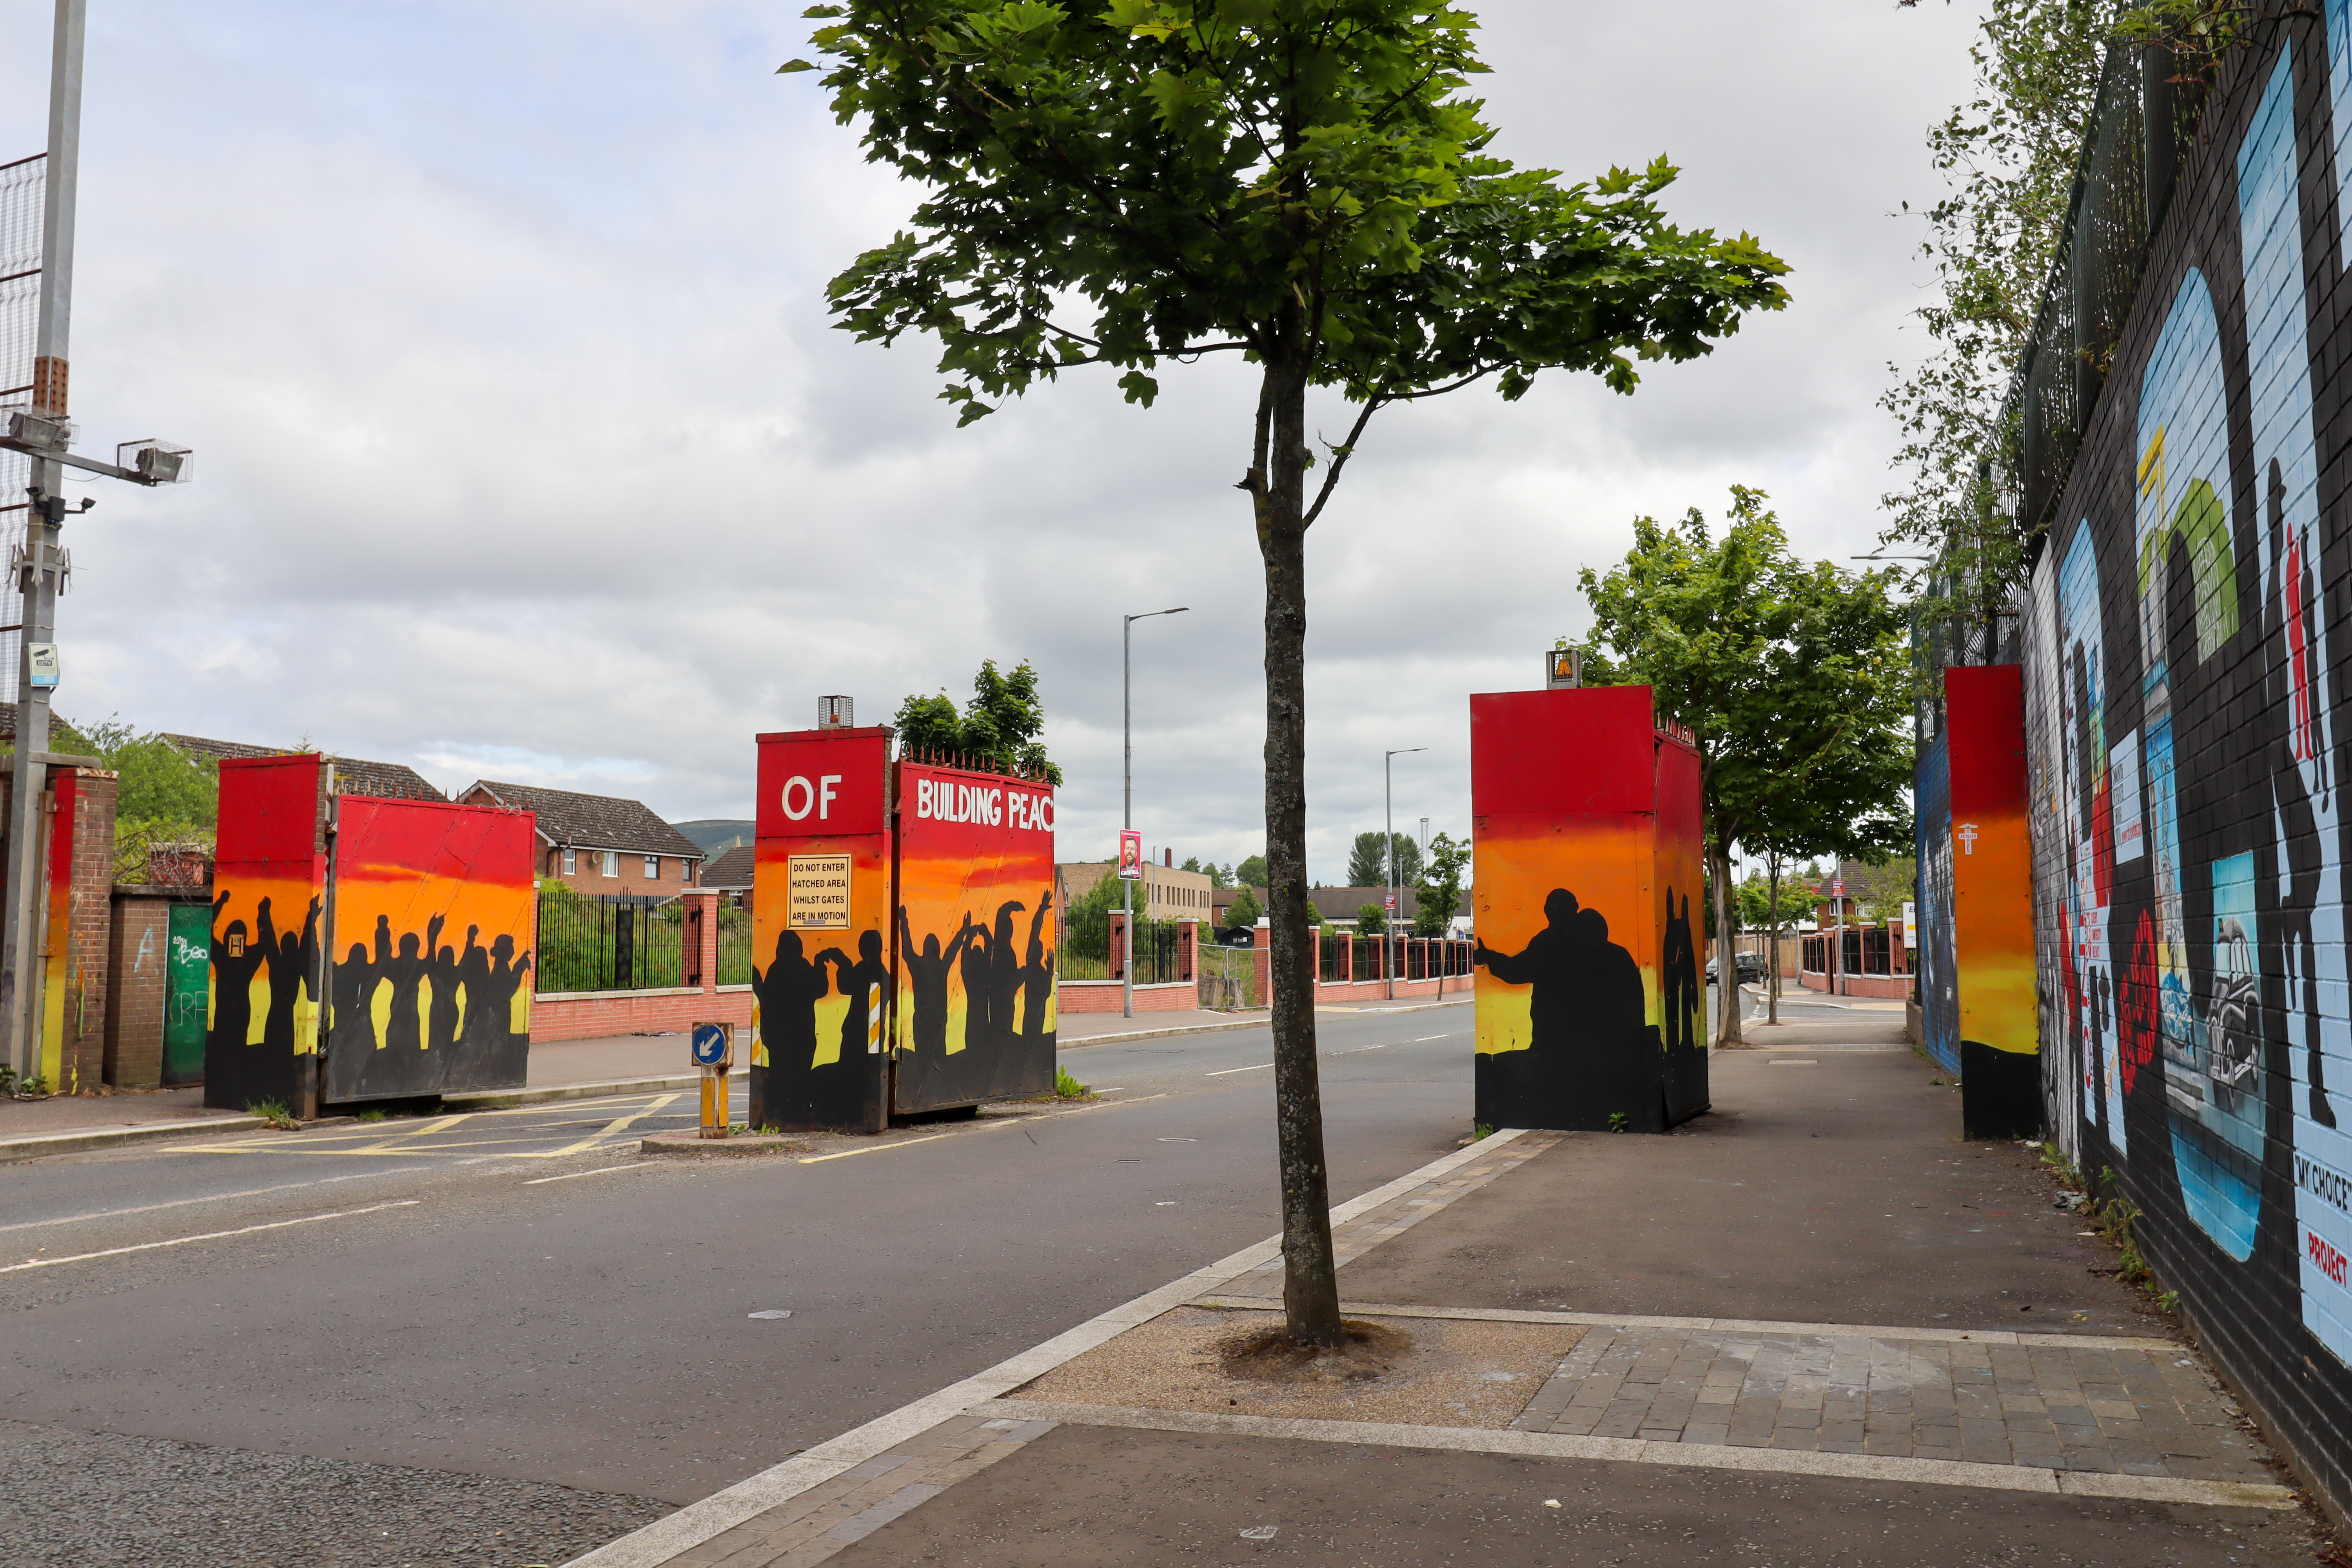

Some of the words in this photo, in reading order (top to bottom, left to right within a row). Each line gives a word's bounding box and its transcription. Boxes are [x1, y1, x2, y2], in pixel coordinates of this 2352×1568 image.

[782, 775, 842, 821] OF
[917, 779, 1002, 827] BUILDING
[1008, 791, 1054, 833] PEAC
[792, 880, 825, 888] HATCHED
[827, 879, 846, 887] AREA
[2308, 1231, 2347, 1288] PROJECT
